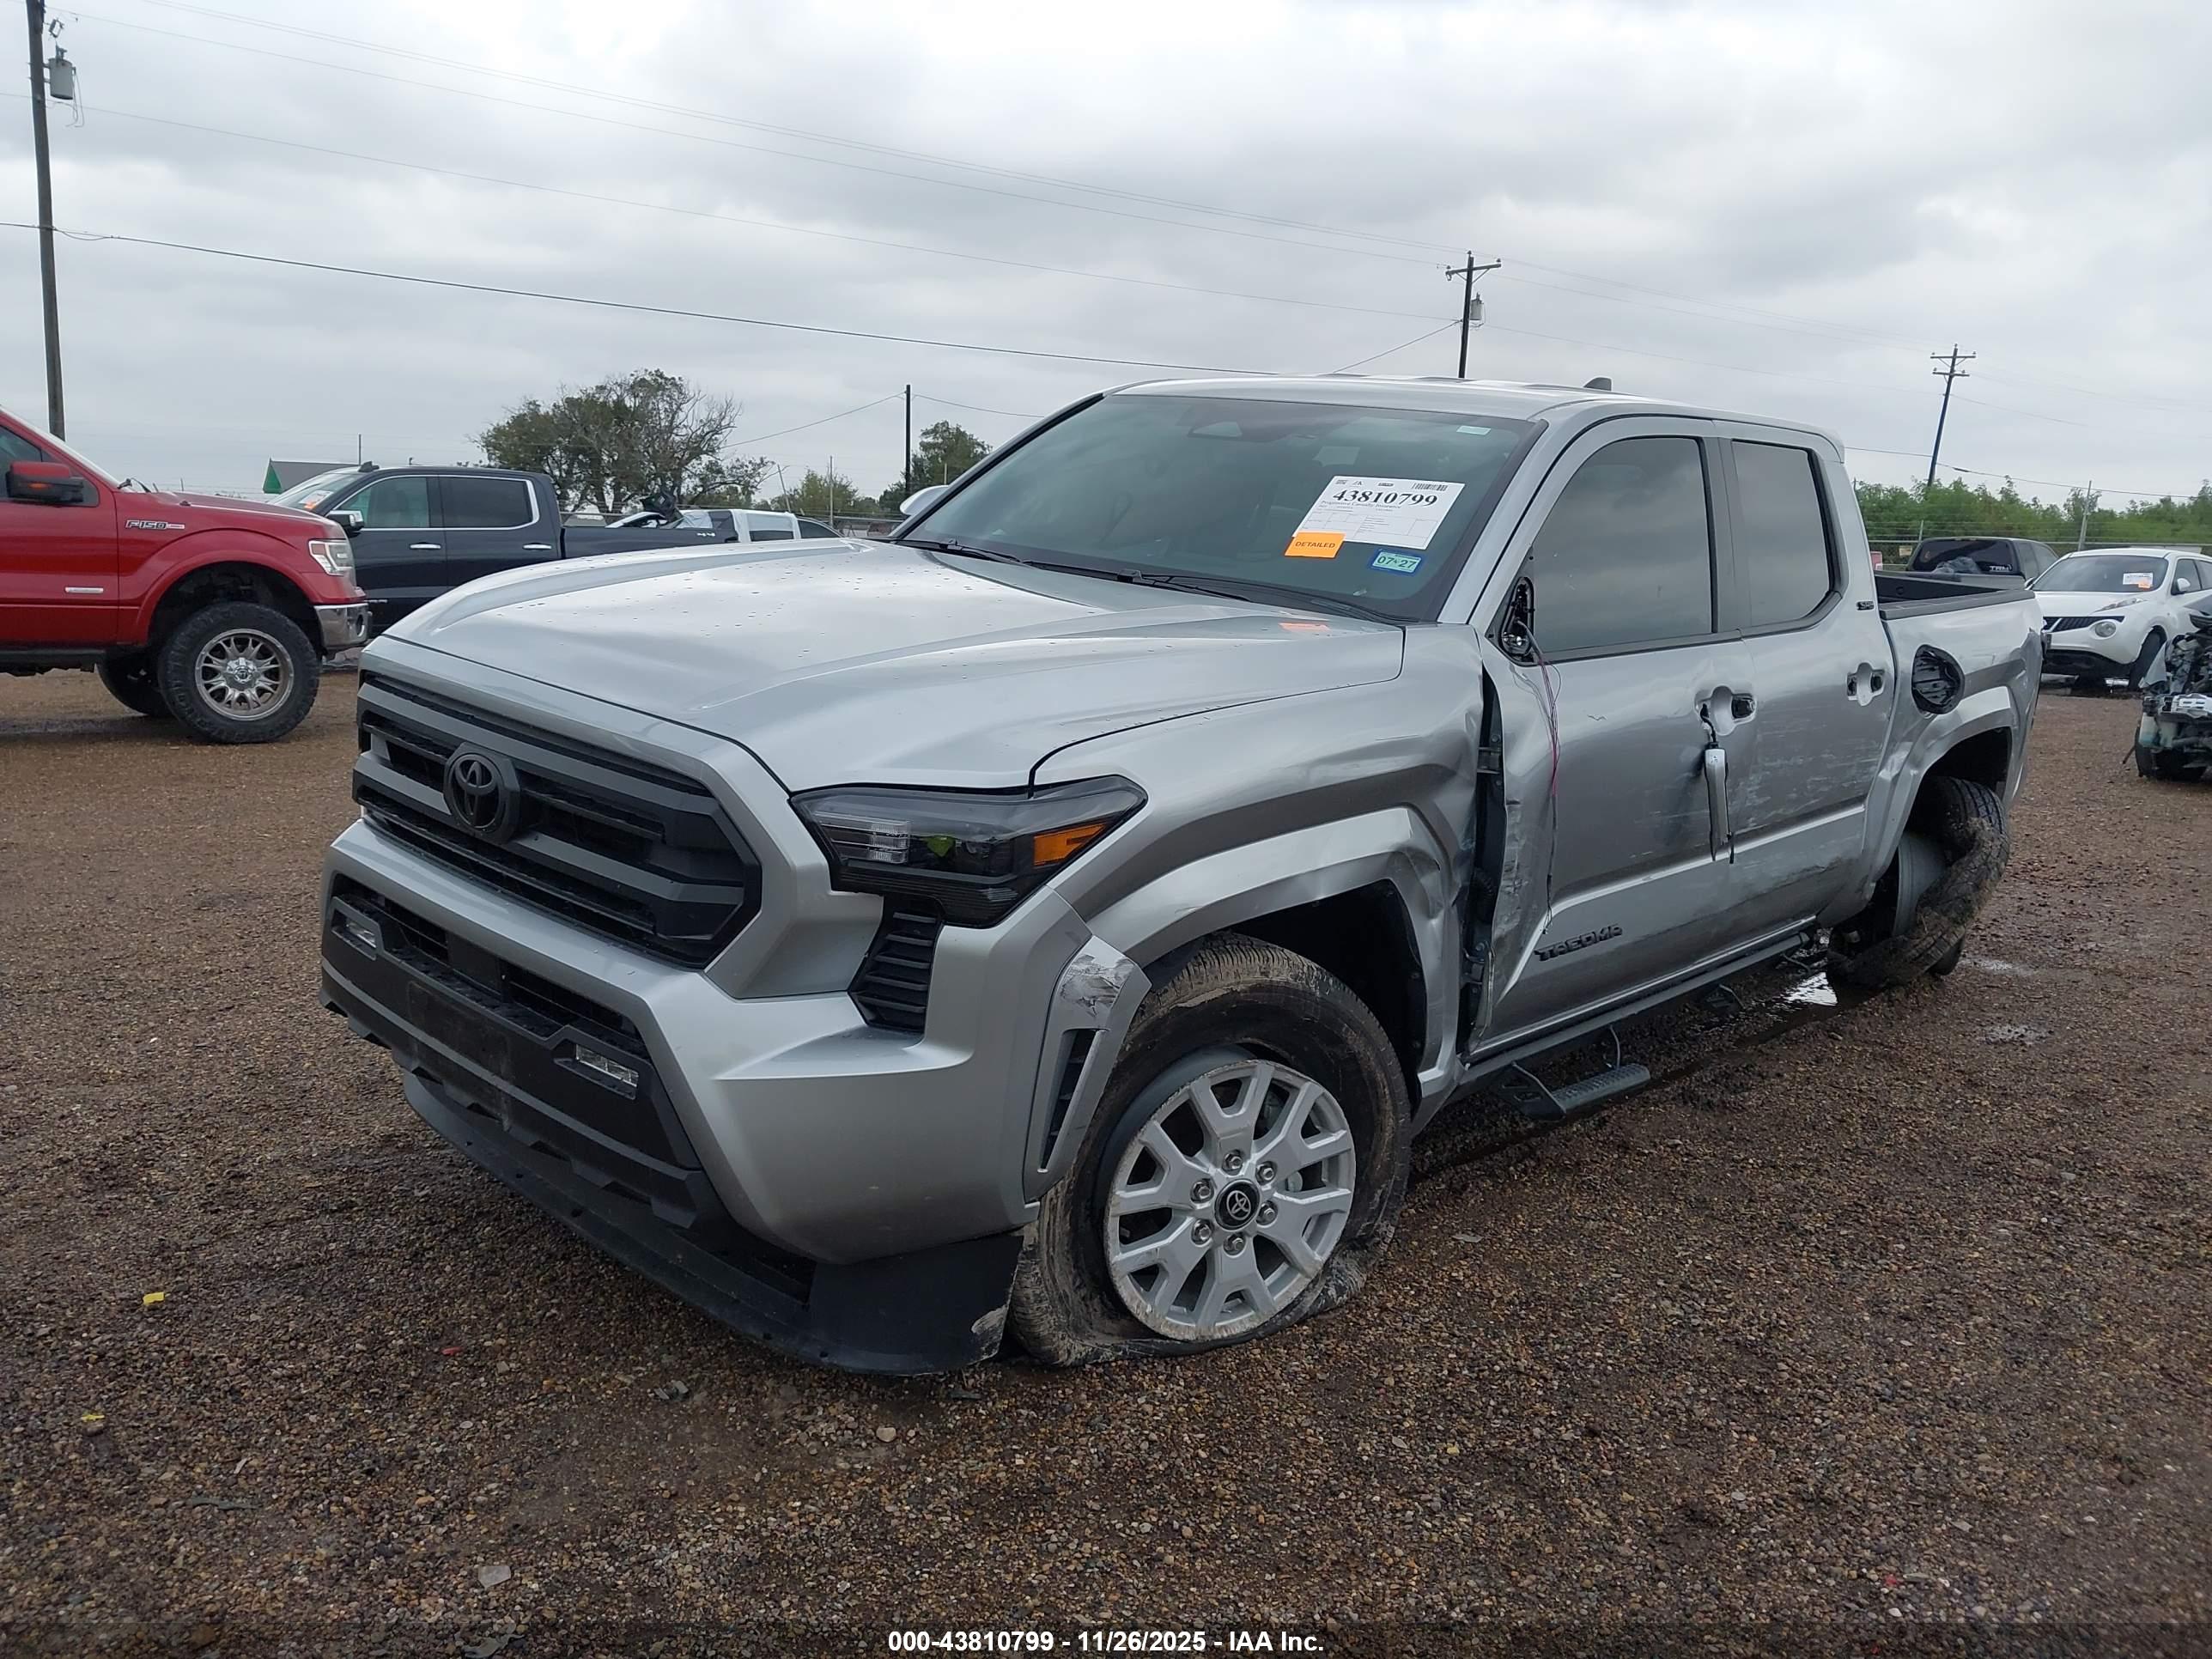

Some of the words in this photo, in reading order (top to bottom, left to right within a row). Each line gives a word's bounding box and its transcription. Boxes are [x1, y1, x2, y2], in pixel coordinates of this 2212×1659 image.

[1333, 489, 1438, 507] 43810799
[1376, 556, 1395, 565] 07
[1398, 559, 1417, 568] 27
[1534, 923, 1623, 962] TACOMA
